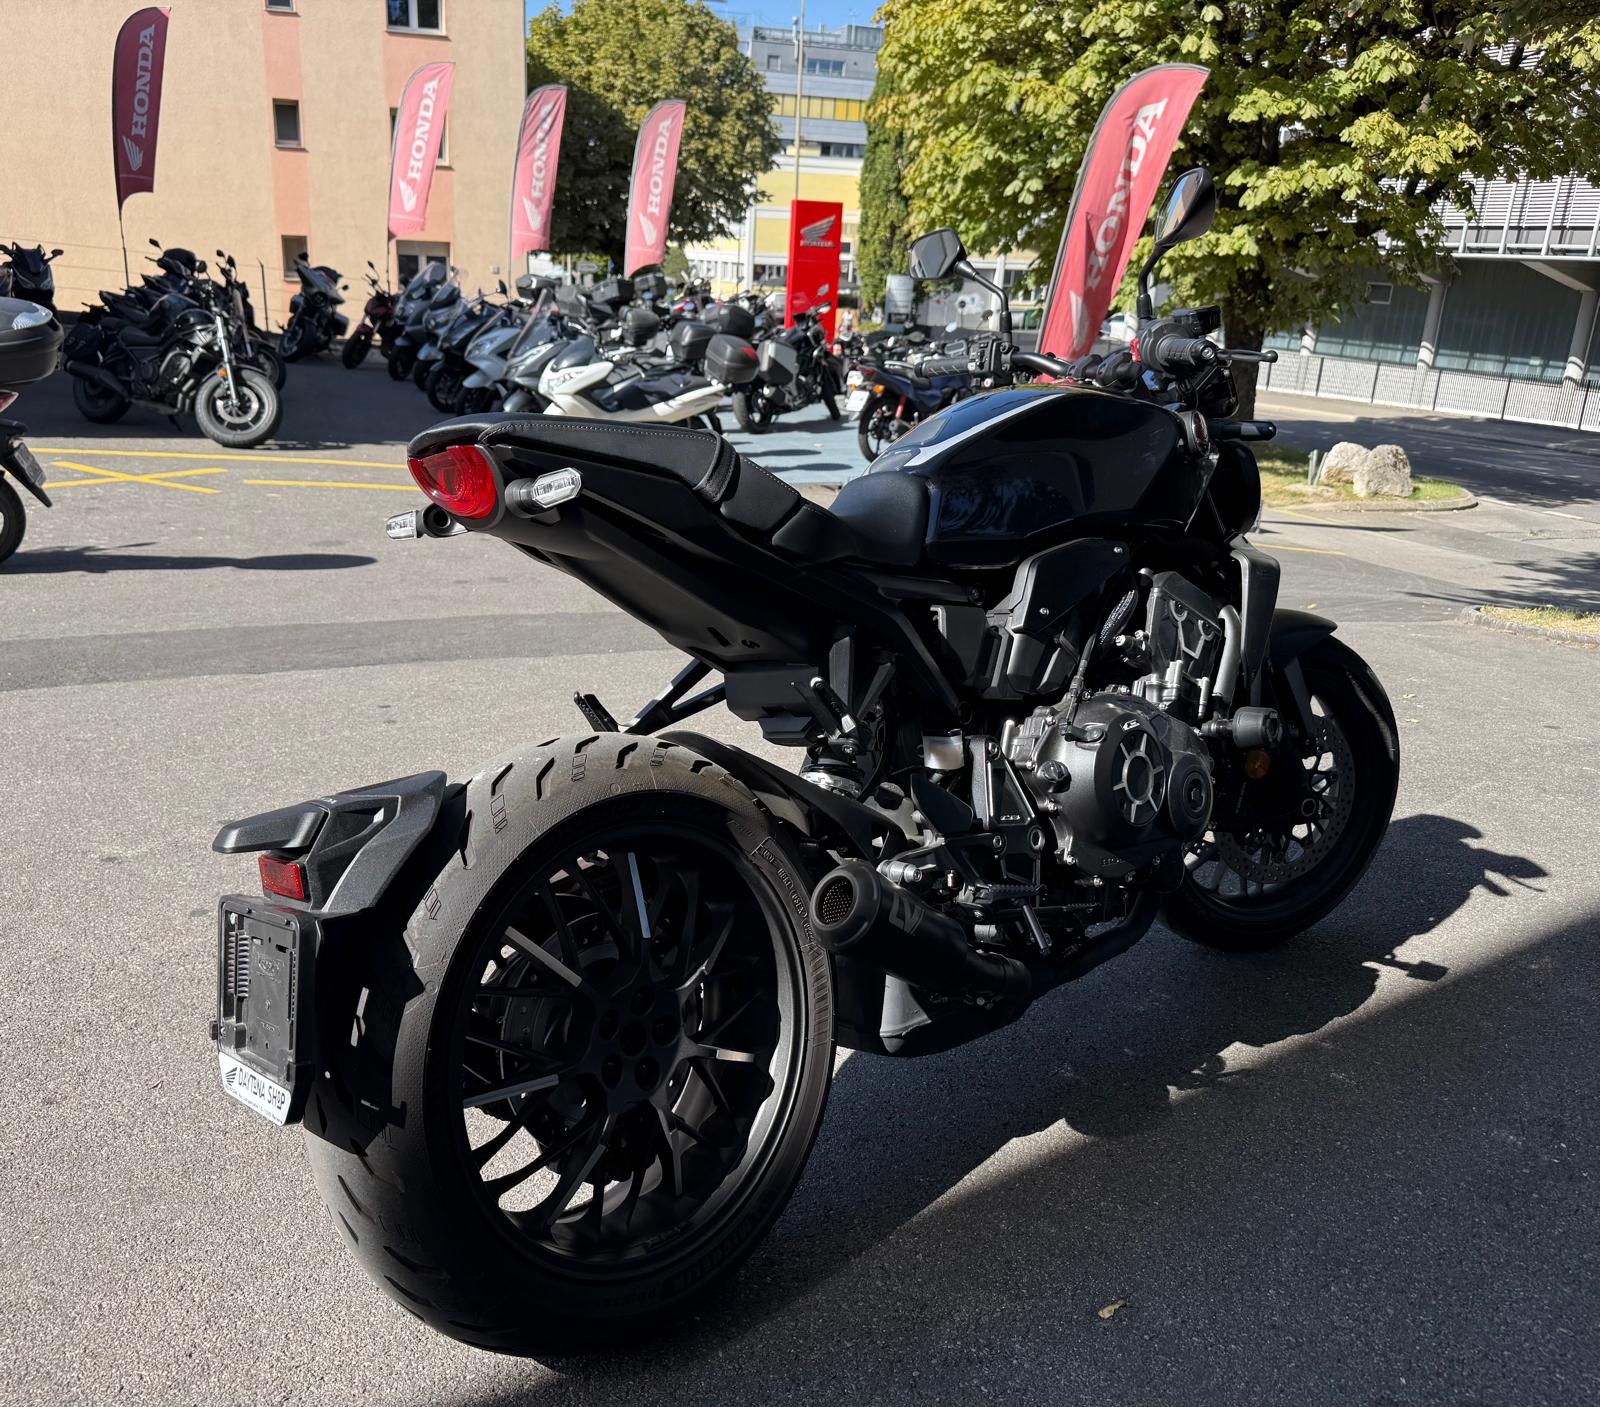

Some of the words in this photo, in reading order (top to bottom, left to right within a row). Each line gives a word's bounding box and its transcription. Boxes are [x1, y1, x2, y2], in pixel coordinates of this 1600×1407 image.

[131, 24, 155, 138] HONDA
[407, 77, 439, 182] HONDA
[647, 117, 672, 216] HONDA
[1086, 97, 1168, 291] HONDA
[238, 1067, 266, 1101] DAYTONA
[267, 1085, 286, 1111] SHOP
